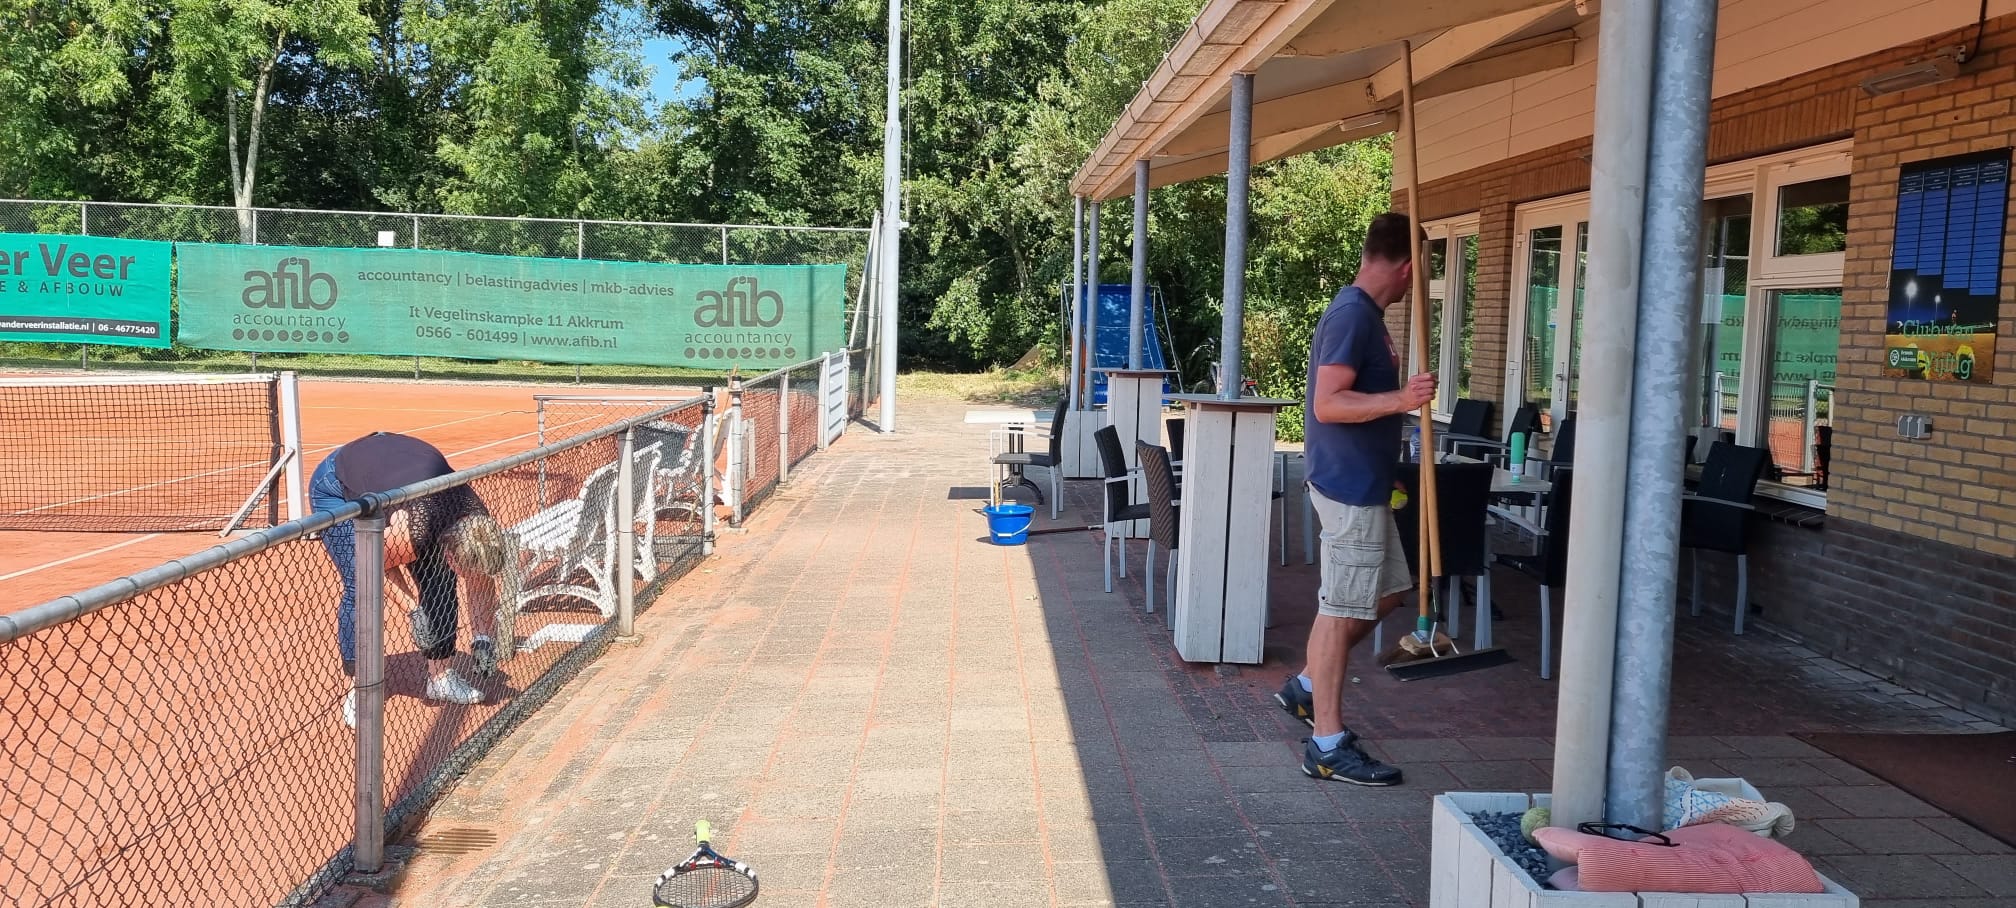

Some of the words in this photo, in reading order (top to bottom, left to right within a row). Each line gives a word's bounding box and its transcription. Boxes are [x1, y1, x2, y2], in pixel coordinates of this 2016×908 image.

[38, 243, 136, 280] Veer
[18, 281, 29, 293] &
[39, 281, 124, 297] AFBOUW
[241, 257, 338, 311] afib
[358, 270, 452, 286] accountancy
[465, 273, 578, 292] belastingadvies
[591, 281, 674, 297] mkb-advies
[693, 276, 784, 328] afib
[233, 313, 346, 330] accountancy
[409, 305, 420, 318] It
[424, 307, 543, 327] Vegelinskampke
[547, 315, 563, 327] 11
[566, 315, 624, 329] Akkrum
[98, 323, 109, 332] 06
[115, 324, 156, 334] 46775420
[416, 326, 452, 339] 0566
[467, 329, 518, 343] 601499
[531, 335, 618, 348] www.afib.nl
[684, 333, 792, 346] accountancy
[1903, 319, 1940, 338] Club
